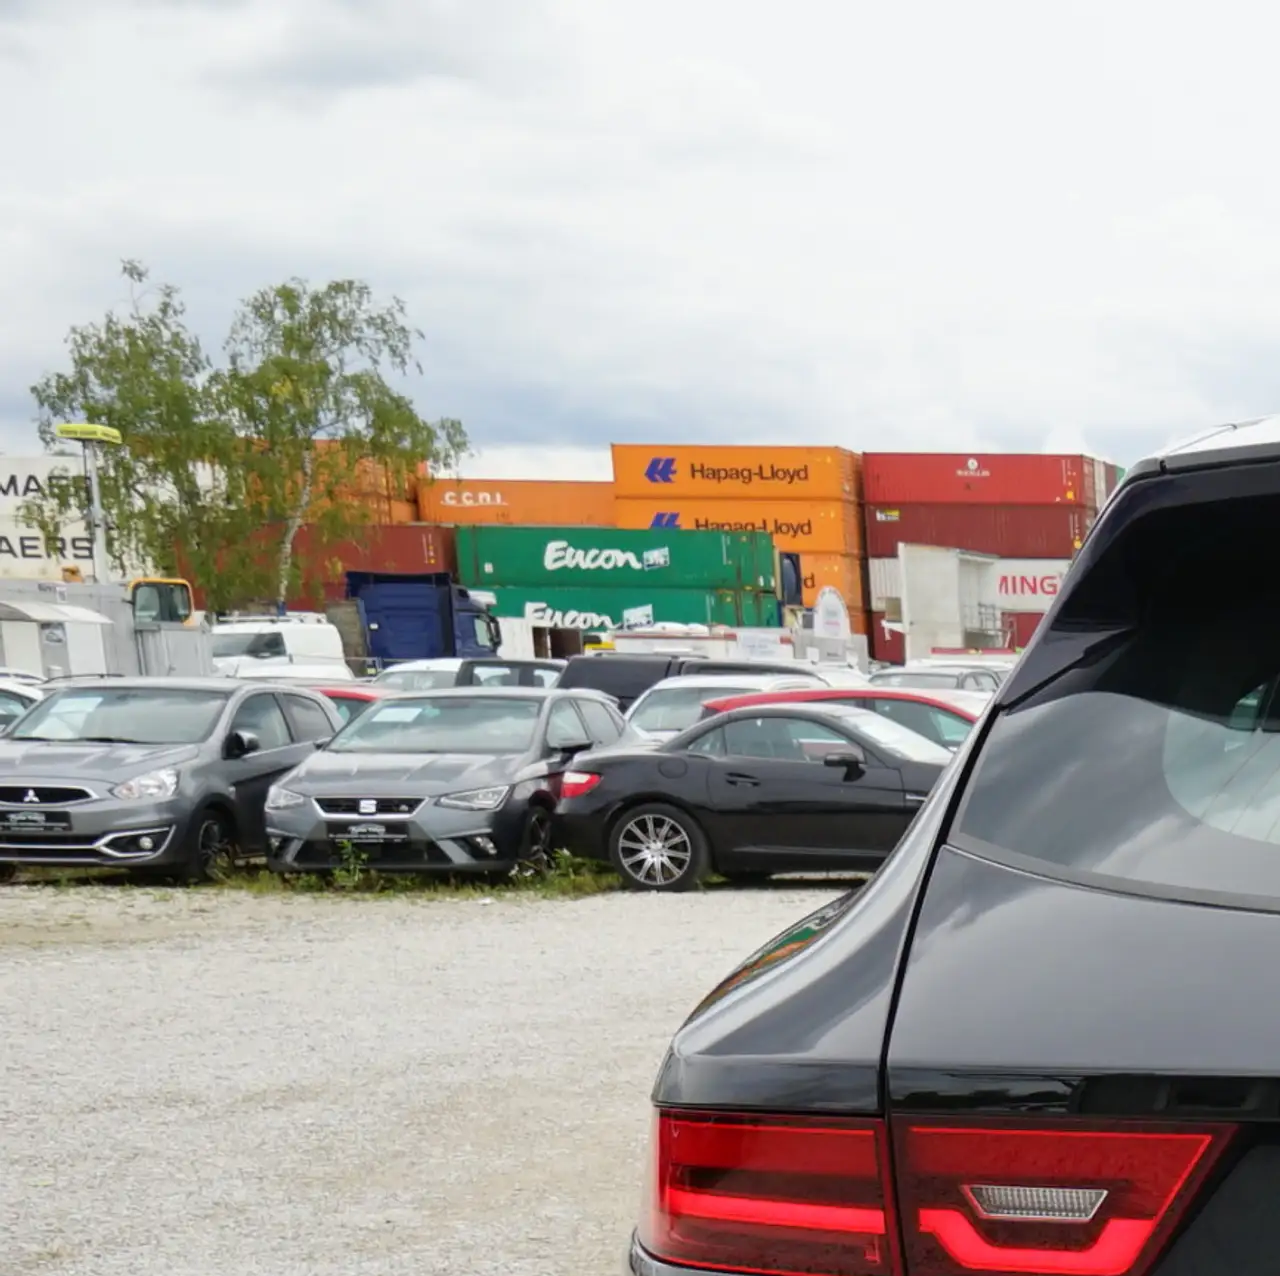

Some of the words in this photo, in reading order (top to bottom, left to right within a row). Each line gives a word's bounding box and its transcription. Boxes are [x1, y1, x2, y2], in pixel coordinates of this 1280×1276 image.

[690, 463, 809, 484] Hapag-Lloyd
[544, 540, 642, 571] Eucon
[524, 601, 620, 630] Eucon
